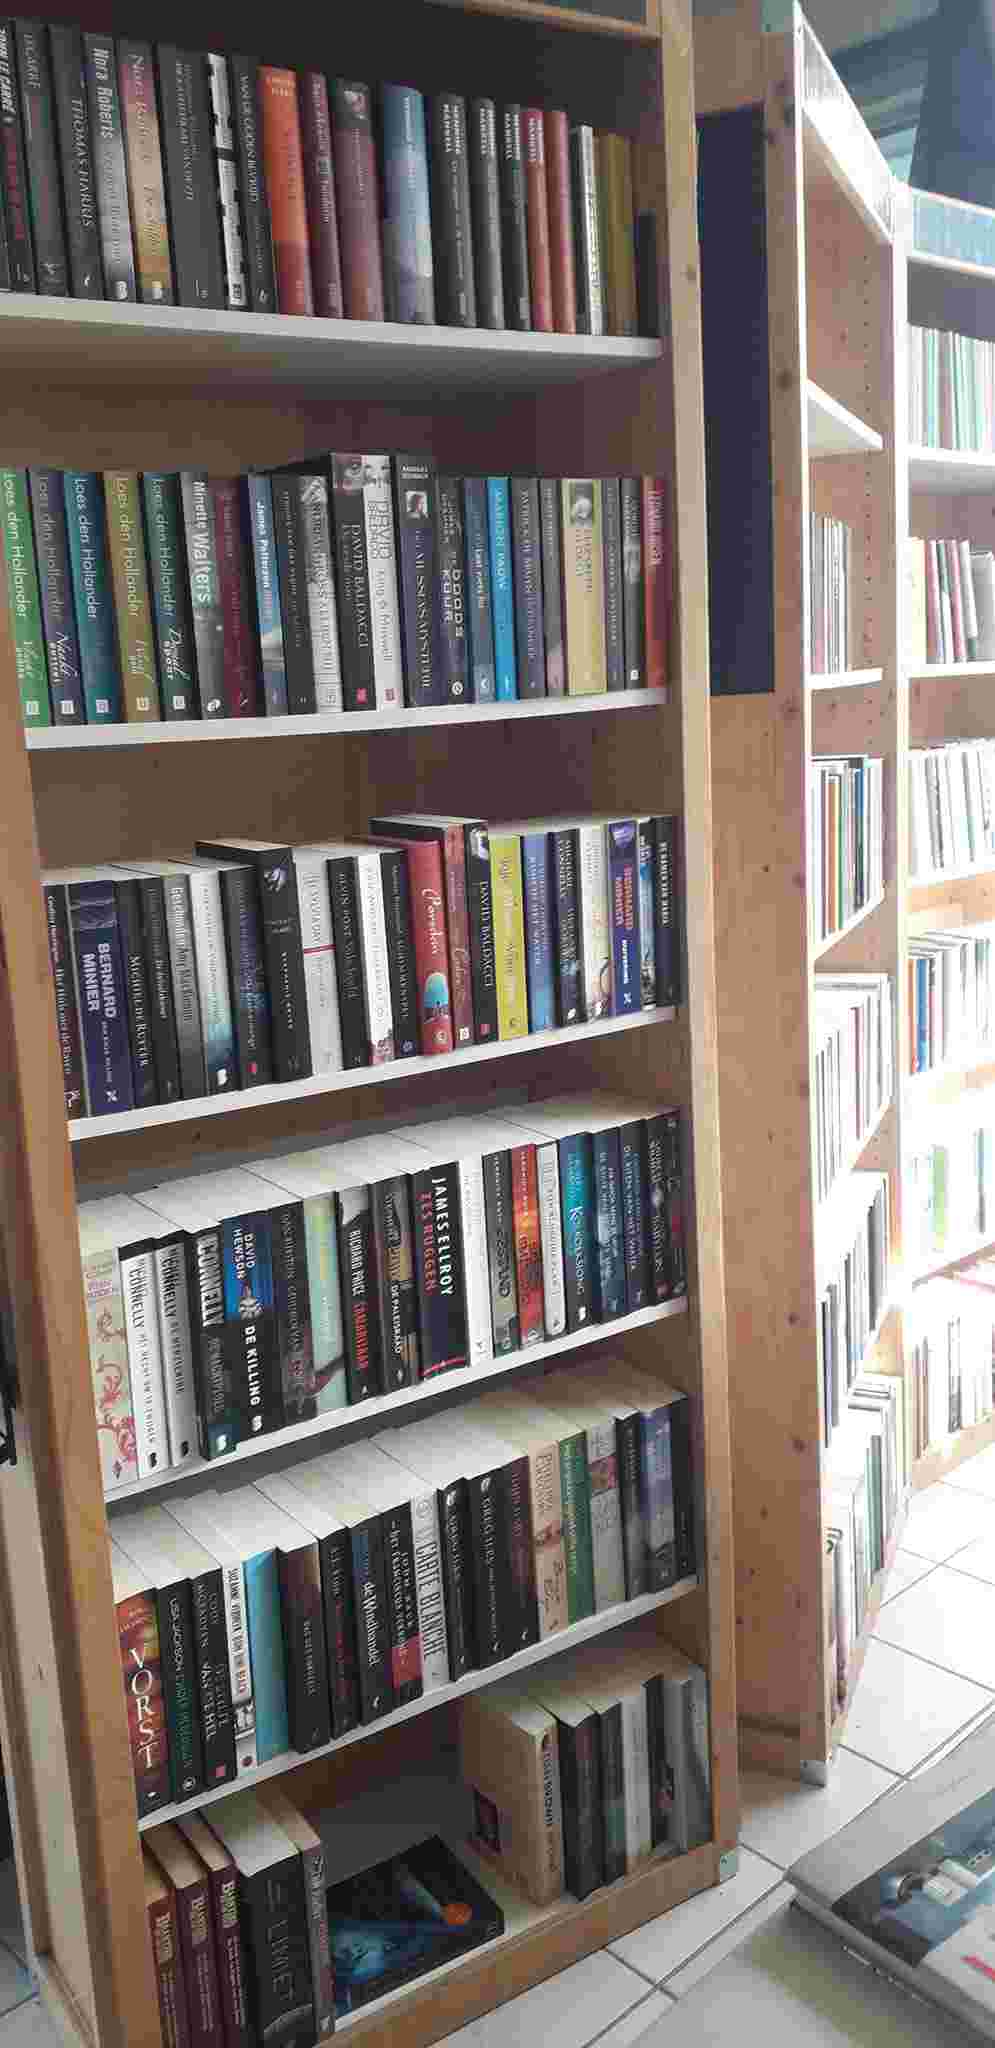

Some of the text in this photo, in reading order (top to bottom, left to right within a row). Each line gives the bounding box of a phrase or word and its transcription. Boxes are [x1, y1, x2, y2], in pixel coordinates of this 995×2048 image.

[92, 47, 108, 81] Nora
[96, 86, 115, 139] Roberts
[72, 99, 96, 227] THOMAS HARRIS
[3, 473, 32, 618] Loes den Hollander
[40, 512, 56, 540] den
[74, 479, 102, 619] Loes den Hollander
[116, 478, 144, 617] Loes den Hollander
[152, 479, 177, 617] Loes den Hollander
[193, 480, 216, 604] Minette Walters
[256, 501, 271, 589] James Patterson
[44, 547, 66, 617] Hollander
[351, 523, 369, 649] DAVID BALDACCI
[479, 880, 494, 988] DAVID BALDACCI
[622, 863, 634, 930] BERNARD
[81, 952, 101, 1012] MINIER
[97, 942, 118, 1018] BERNARD
[232, 1228, 245, 1279] HEWSON
[244, 1232, 256, 1268] DAVID
[349, 1230, 363, 1268] RICHARD
[422, 1222, 439, 1297] RUGGEN
[432, 1177, 454, 1297] JAMES ELLROY
[129, 1267, 146, 1329] CONNELLY
[160, 1258, 177, 1319] CONNELLY
[198, 1237, 223, 1327] CONNELLY
[351, 1269, 366, 1297] PRICE
[245, 1325, 261, 1406] DE KILLING
[362, 1583, 381, 1666] de Windhandel
[415, 1541, 446, 1660] CARTE BLANCHE
[172, 1622, 185, 1671] JACKSON
[129, 1645, 158, 1769] VORST
